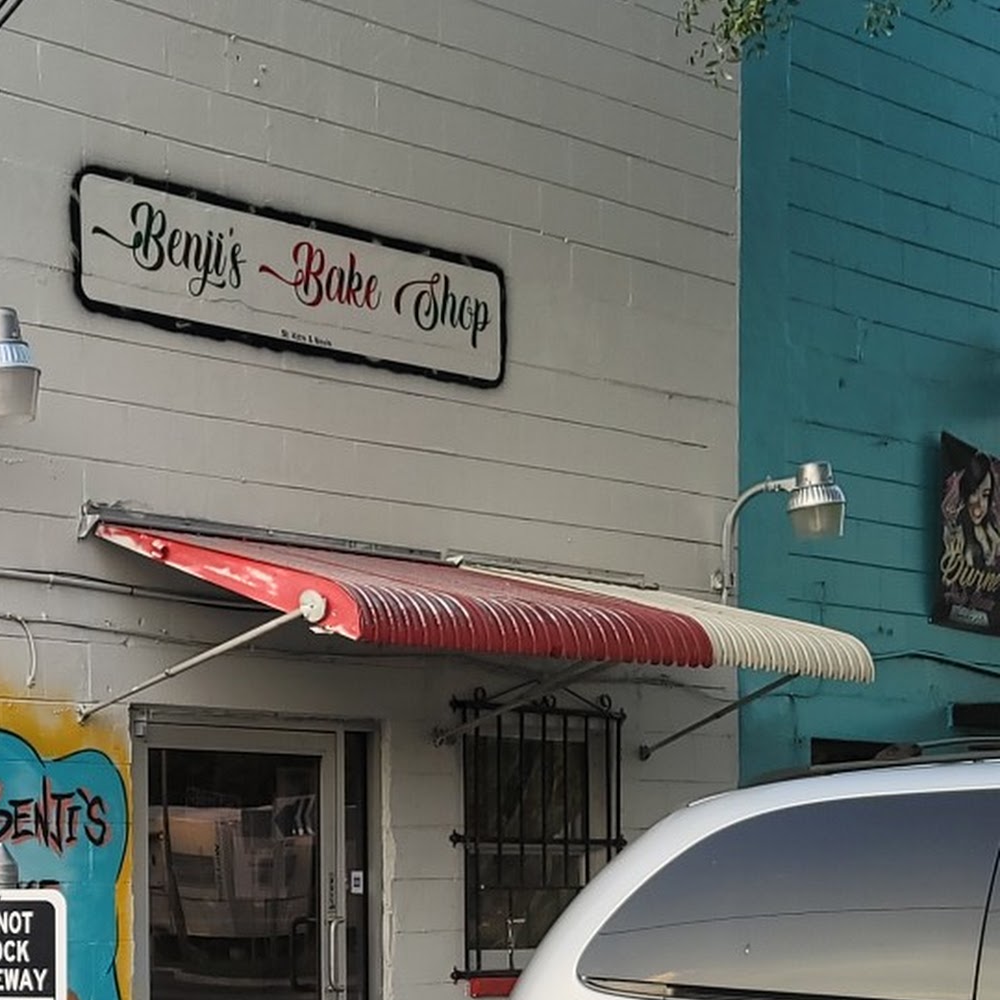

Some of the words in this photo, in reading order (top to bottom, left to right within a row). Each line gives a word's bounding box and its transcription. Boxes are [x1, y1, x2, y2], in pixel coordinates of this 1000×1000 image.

[92, 201, 246, 297] Benji's
[258, 241, 383, 310] Bake
[394, 273, 492, 348] Shop
